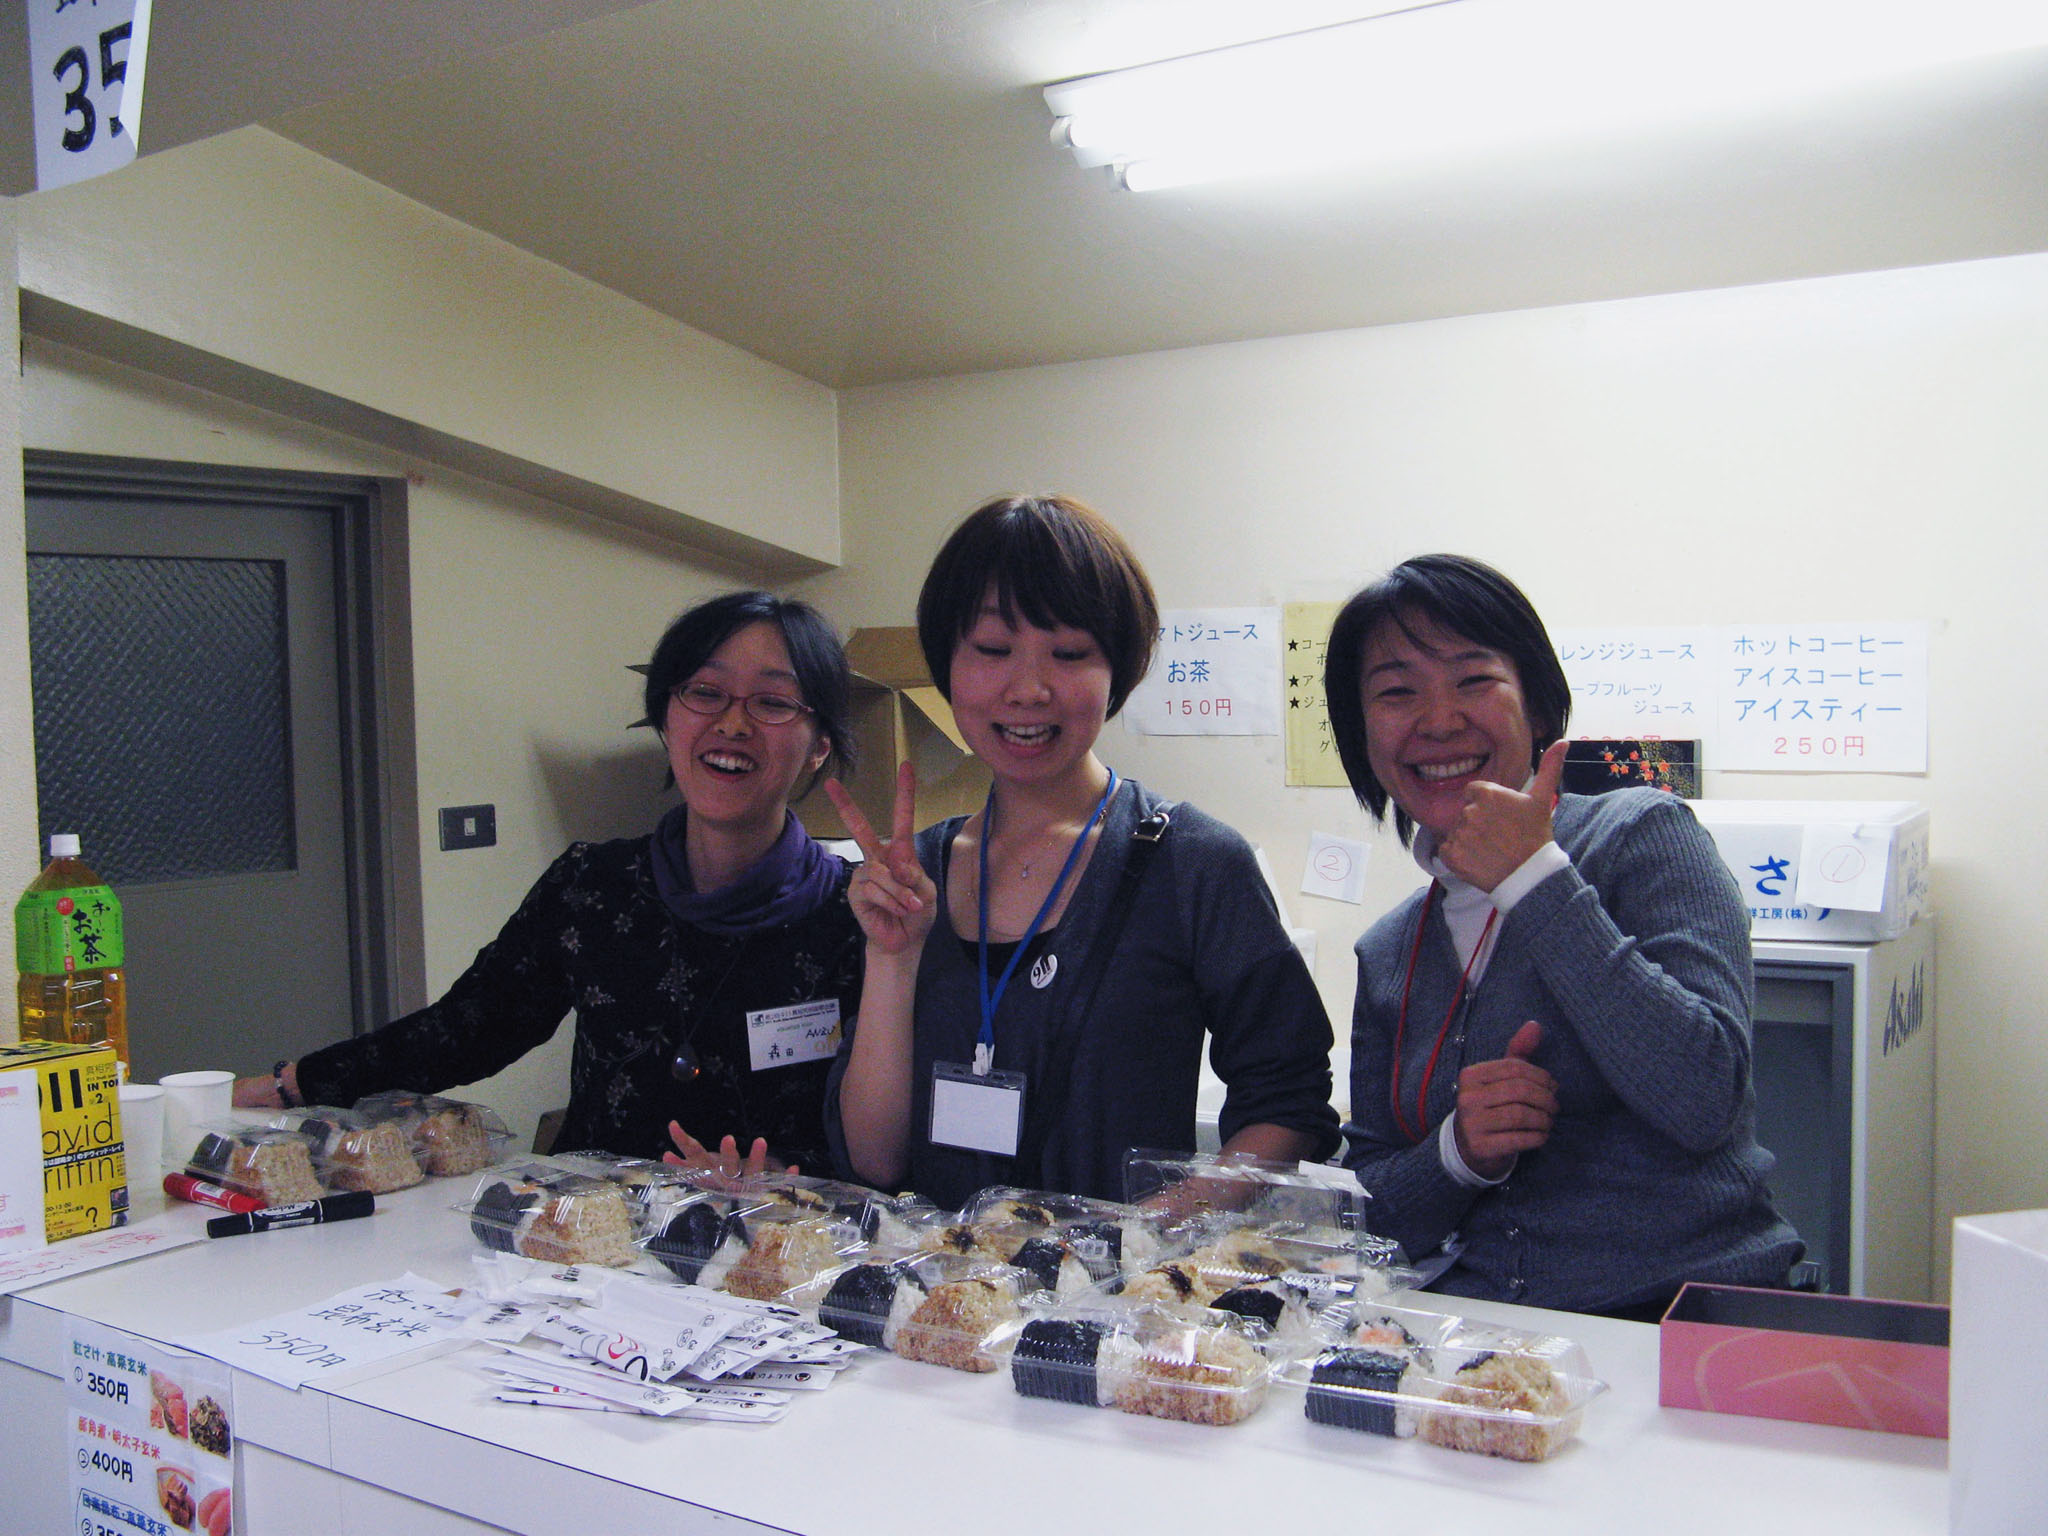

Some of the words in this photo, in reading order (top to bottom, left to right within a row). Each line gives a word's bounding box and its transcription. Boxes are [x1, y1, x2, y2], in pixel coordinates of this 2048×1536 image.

[1734, 634, 1903, 656] ホットコーヒー
[1168, 660, 1210, 683] お茶
[1733, 667, 1903, 687] アイスコーヒー
[1165, 699, 1231, 716] 150円
[1634, 700, 1695, 714] ジュース
[1734, 698, 1903, 722] アイスティー
[1774, 736, 1864, 756] 250円
[88, 1082, 99, 1092] IN
[239, 1330, 347, 1368] 350円
[87, 1372, 129, 1404] 350円
[92, 1450, 133, 1483] 400円
